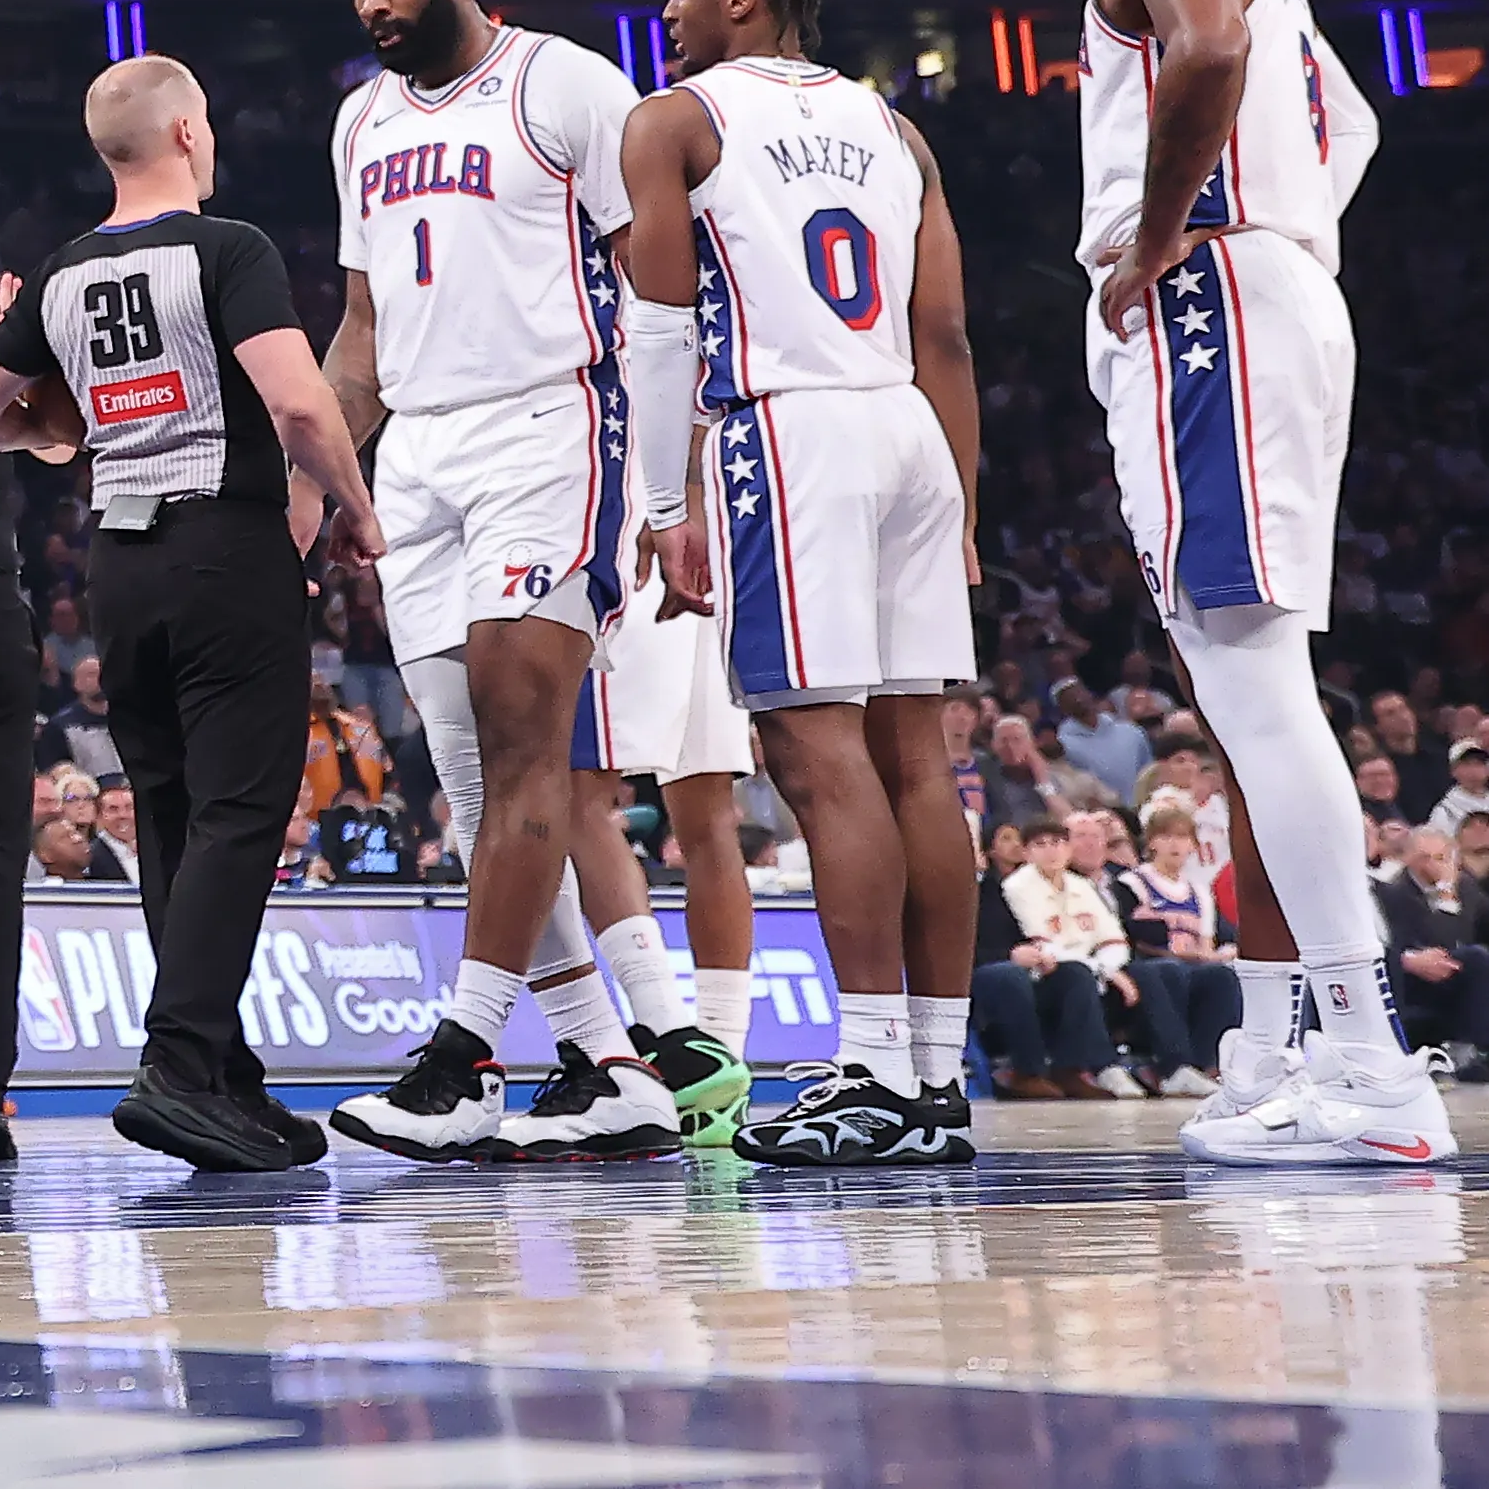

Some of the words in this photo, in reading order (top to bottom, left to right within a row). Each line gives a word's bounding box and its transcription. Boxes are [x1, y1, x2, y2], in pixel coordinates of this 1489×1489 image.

[360, 142, 496, 222] PHILA
[763, 135, 876, 189] MAXEY
[412, 218, 433, 288] 1
[802, 206, 883, 332] 0
[84, 272, 165, 369] 39
[99, 386, 176, 414] Emirates
[503, 563, 553, 601] 76
[1139, 550, 1162, 595] 6
